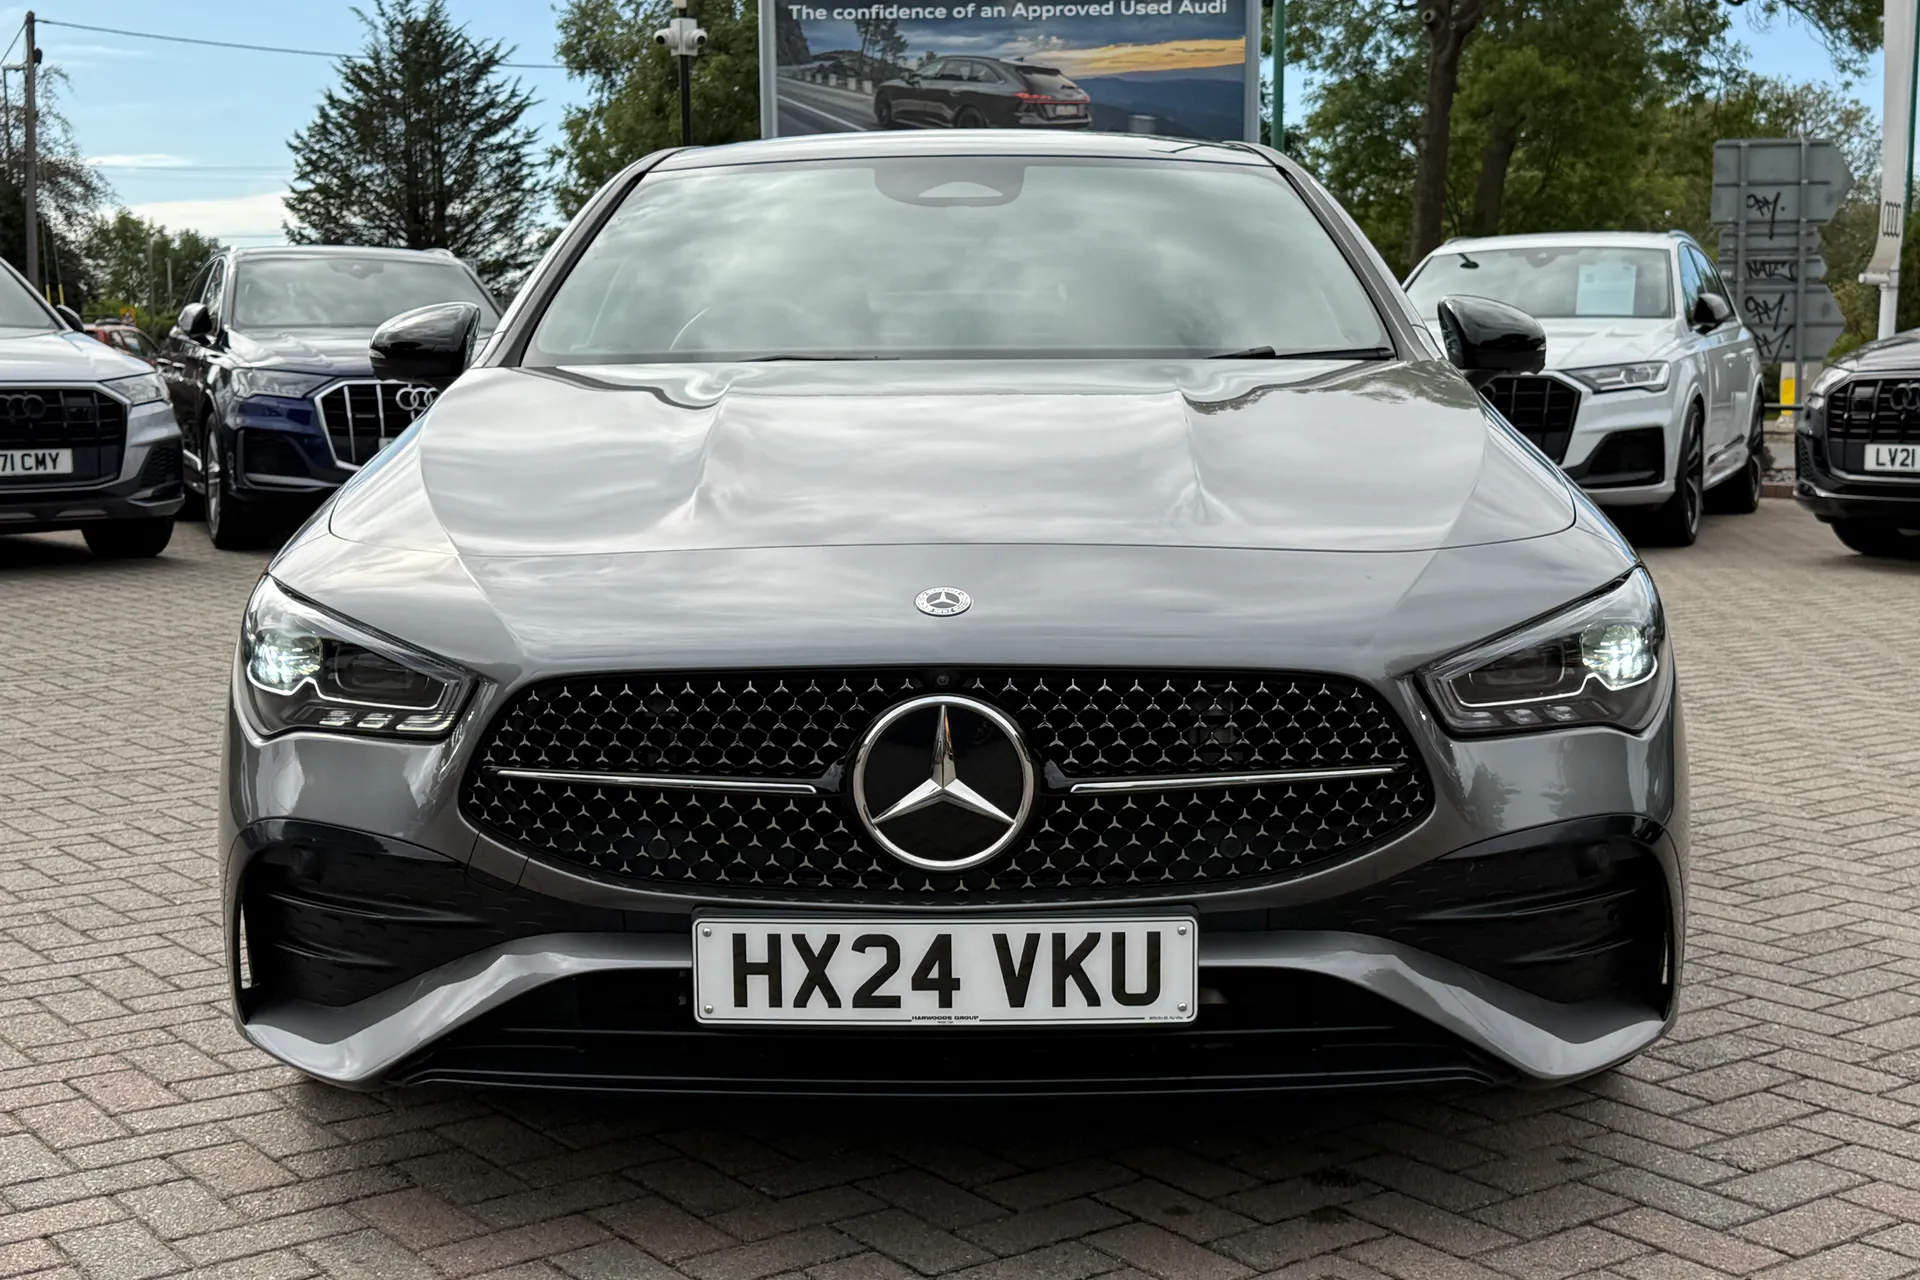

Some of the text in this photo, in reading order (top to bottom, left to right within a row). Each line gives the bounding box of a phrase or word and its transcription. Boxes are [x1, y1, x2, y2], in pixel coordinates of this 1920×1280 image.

[788, 0, 1228, 20] The confidence of an Approved Used Audi
[21, 452, 60, 471] CMY
[1875, 447, 1916, 469] LV21
[732, 931, 1160, 1008] HX24 VKU
